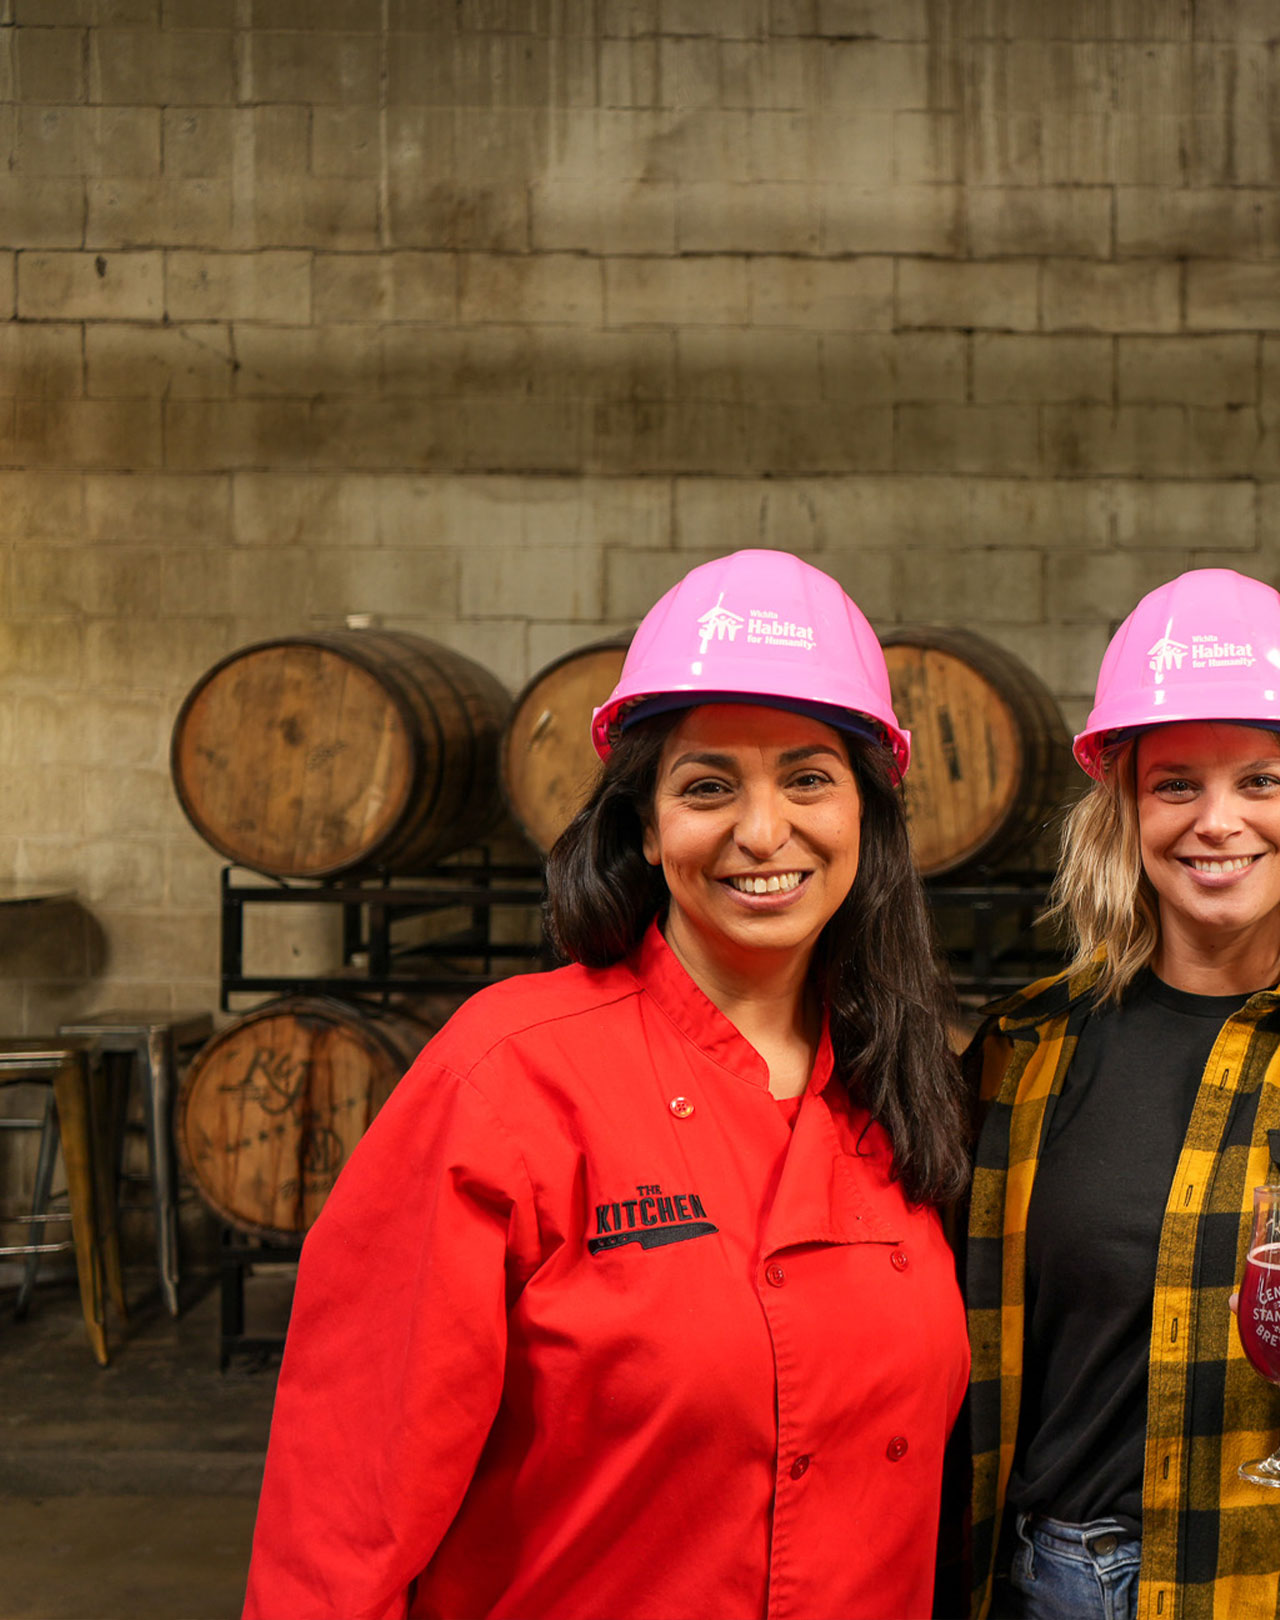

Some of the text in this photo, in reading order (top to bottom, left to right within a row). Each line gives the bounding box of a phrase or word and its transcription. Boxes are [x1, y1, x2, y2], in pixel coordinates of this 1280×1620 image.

[750, 609, 778, 619] Wichita
[747, 618, 814, 641] Habitat
[747, 634, 762, 643] for
[1192, 643, 1253, 658] Habitat
[1192, 660, 1206, 668] for
[637, 1185, 662, 1196] THE
[596, 1194, 707, 1234] KITCHEN
